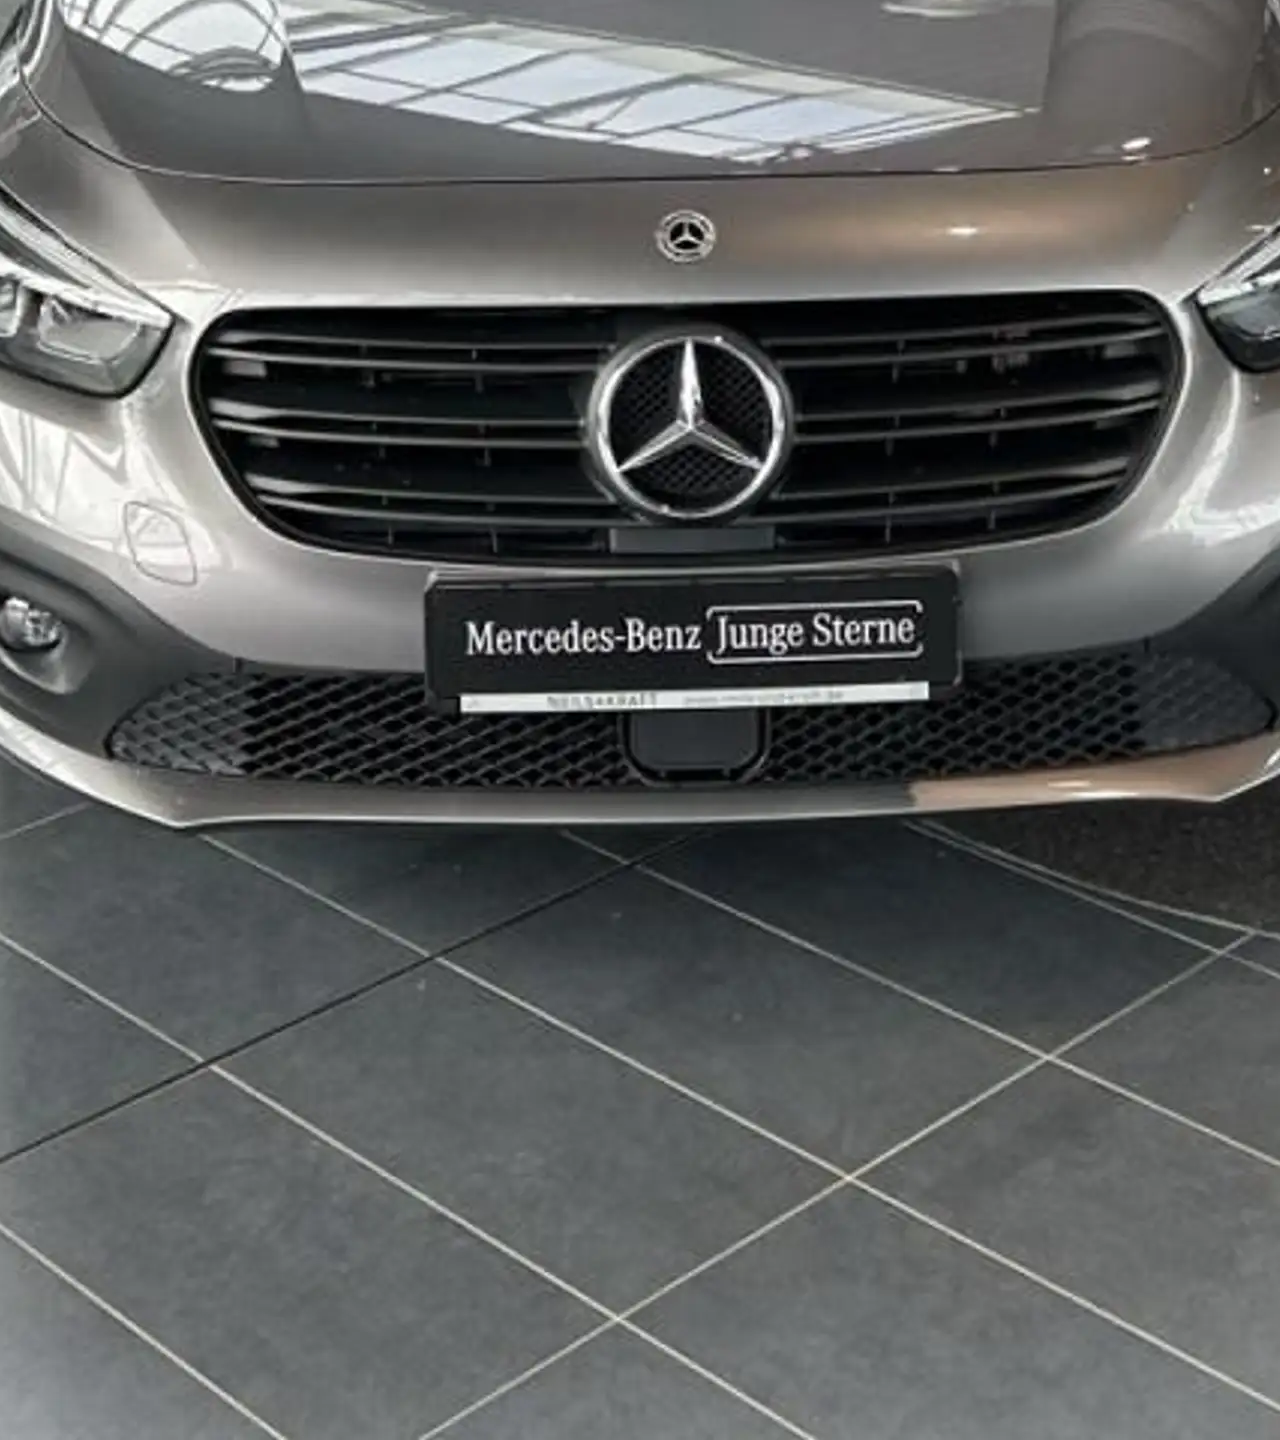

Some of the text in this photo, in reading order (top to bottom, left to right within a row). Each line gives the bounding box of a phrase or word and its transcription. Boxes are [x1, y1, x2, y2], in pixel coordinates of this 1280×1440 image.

[465, 611, 917, 655] Mercedes-Benz Junge Sterne
